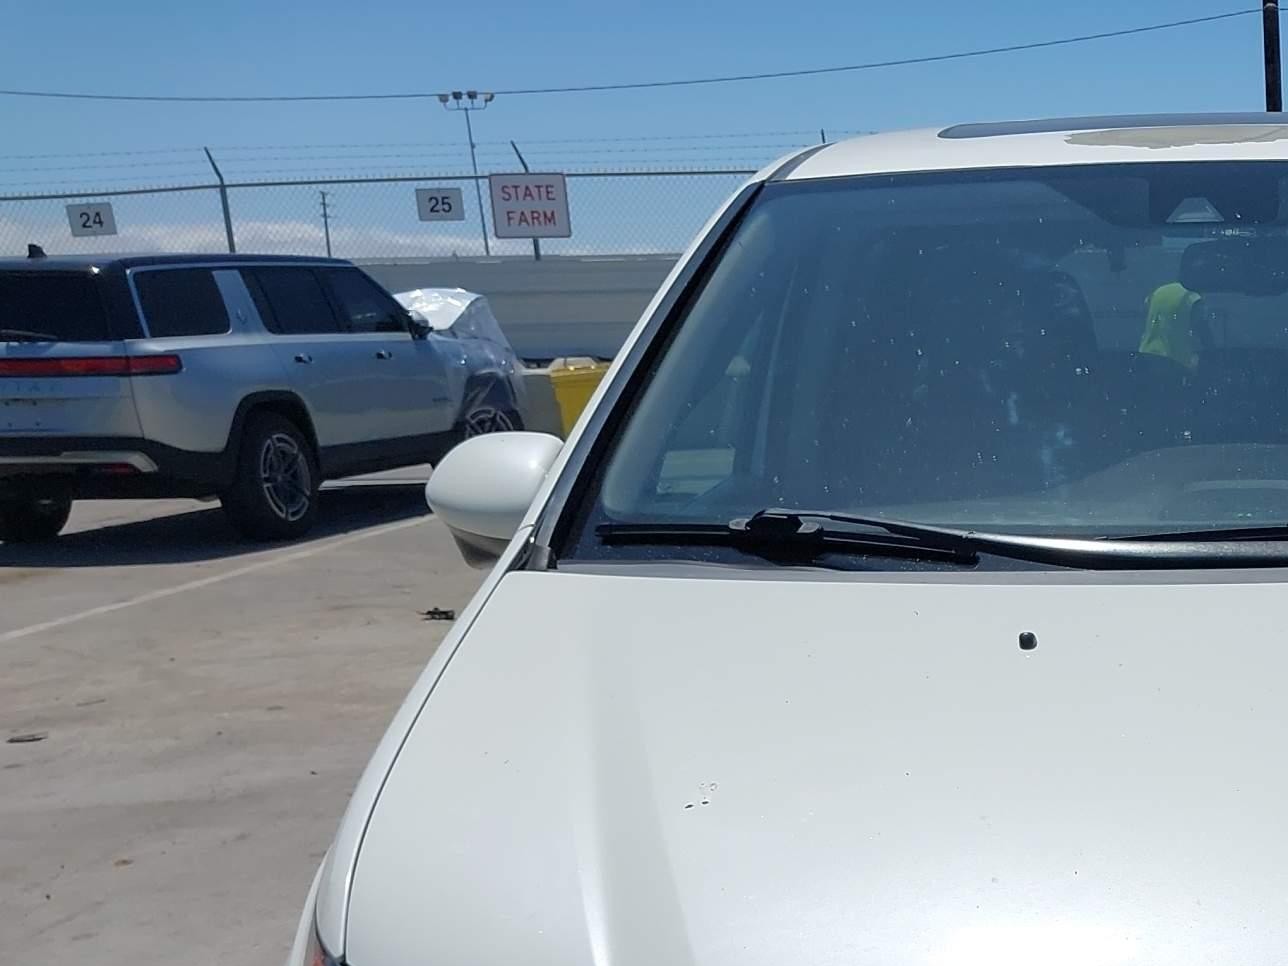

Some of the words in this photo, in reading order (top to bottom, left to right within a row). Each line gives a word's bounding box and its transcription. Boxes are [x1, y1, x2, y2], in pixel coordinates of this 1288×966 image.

[501, 184, 556, 201] STATE
[427, 196, 453, 213] 25
[79, 211, 104, 229] 24
[506, 210, 557, 227] FARM
